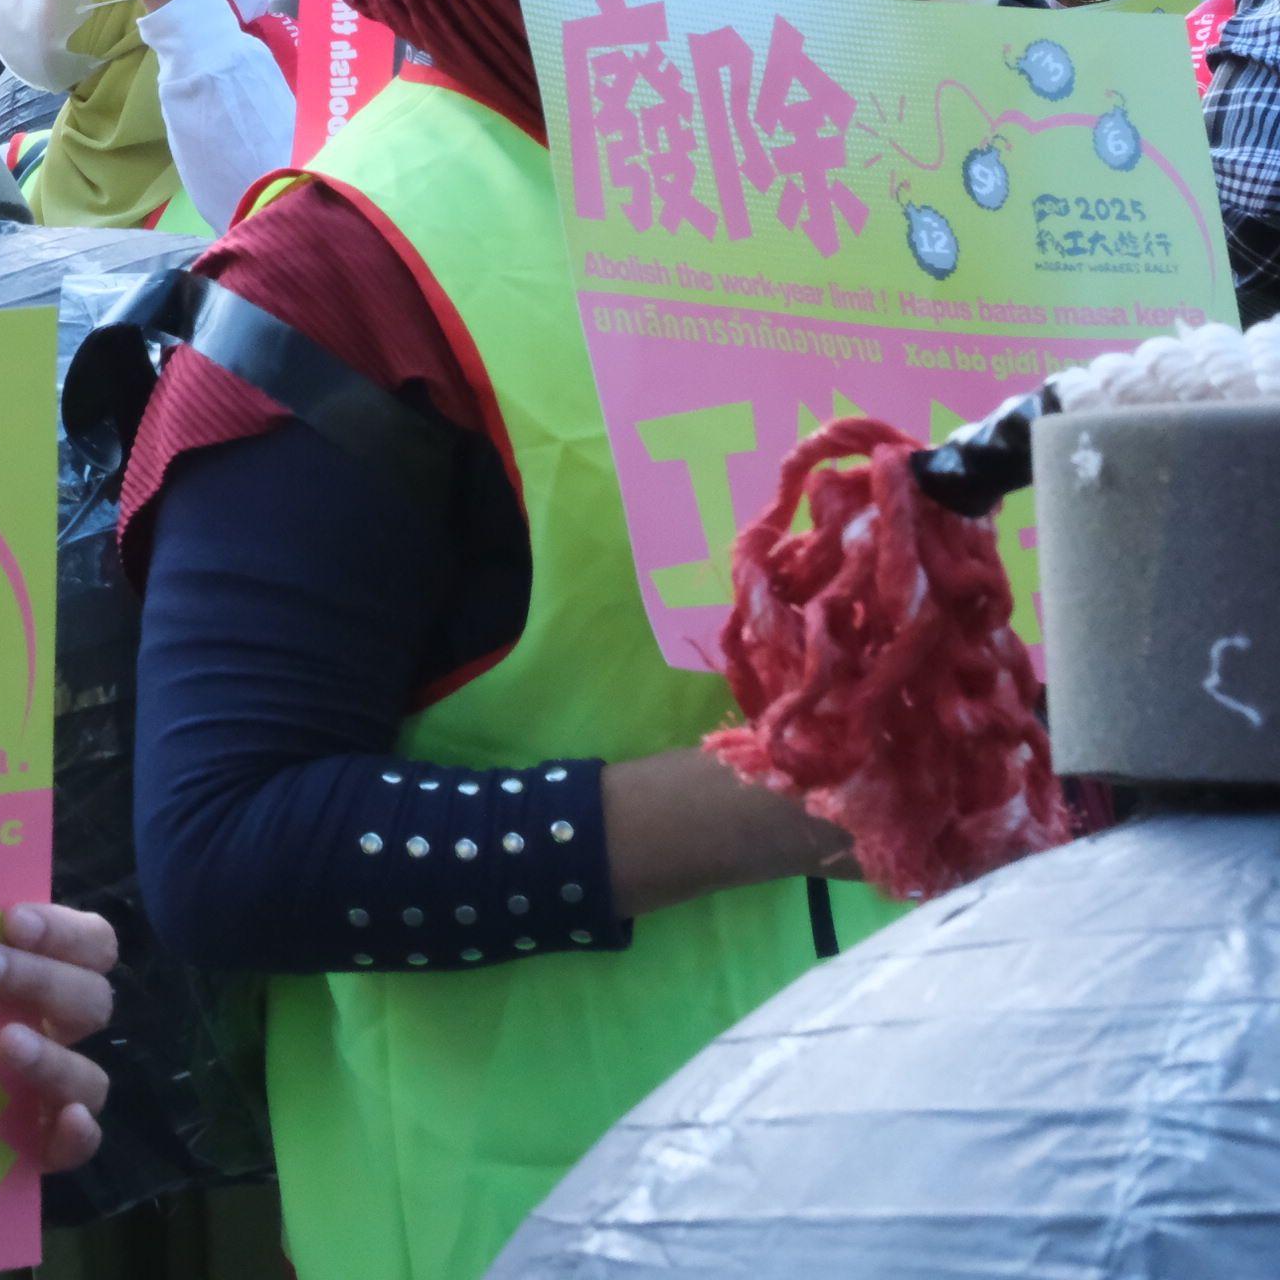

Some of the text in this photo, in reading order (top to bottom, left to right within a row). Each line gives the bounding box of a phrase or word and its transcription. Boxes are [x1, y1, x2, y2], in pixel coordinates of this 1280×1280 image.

[1074, 196, 1146, 222] 2025
[918, 228, 951, 254] 12
[584, 250, 674, 287] Abolish
[675, 261, 715, 293] the
[719, 271, 825, 308] work-year
[827, 281, 877, 313] limit
[897, 291, 973, 325] Hapus
[977, 297, 1048, 325] batas
[1053, 303, 1131, 326] masa
